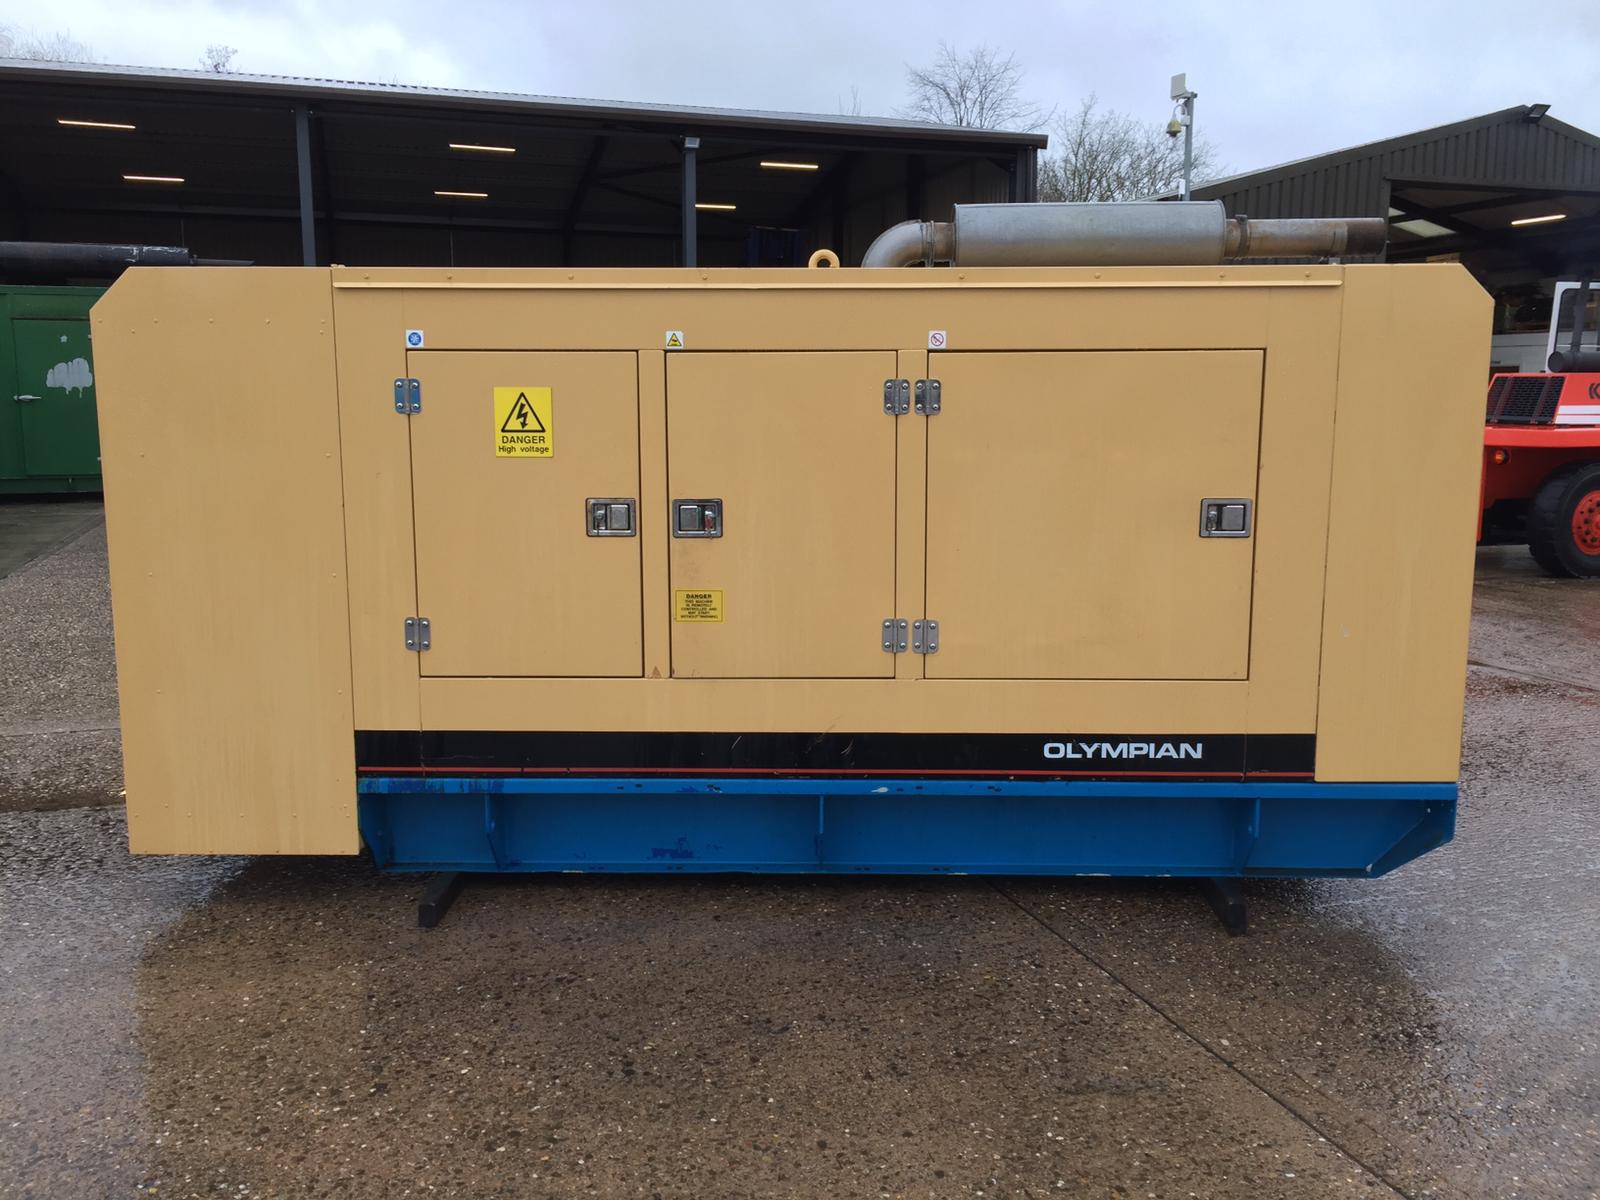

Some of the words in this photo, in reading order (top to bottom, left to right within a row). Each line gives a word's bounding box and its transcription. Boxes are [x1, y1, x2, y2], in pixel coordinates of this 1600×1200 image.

[502, 436, 546, 444] DANGER
[498, 446, 516, 454] High
[520, 446, 549, 454] voltage
[1043, 742, 1203, 759] OLYMPIAN
